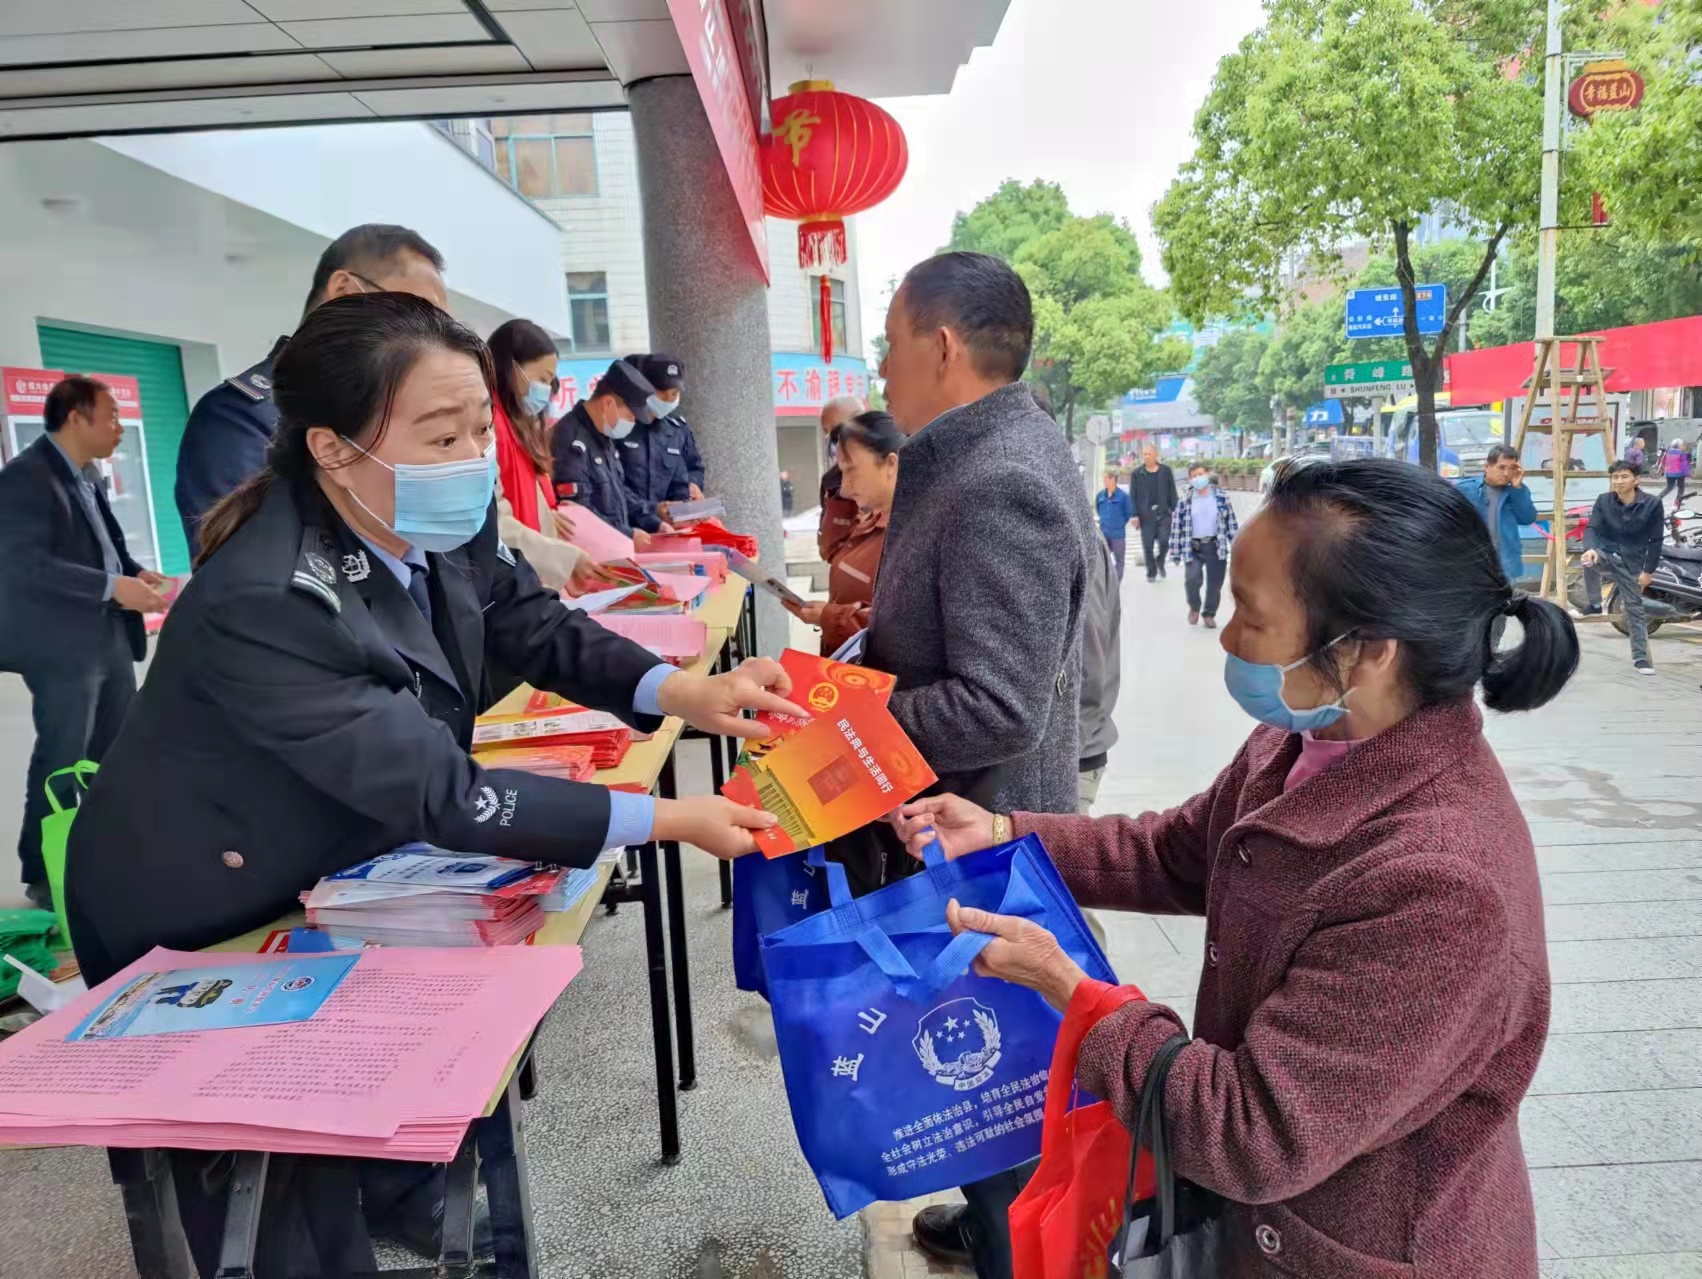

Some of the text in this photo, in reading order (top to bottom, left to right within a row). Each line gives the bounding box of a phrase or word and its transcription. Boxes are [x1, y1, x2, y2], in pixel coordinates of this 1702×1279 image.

[836, 718, 893, 794] 民法典与生活同行
[500, 789, 517, 826] POLICE
